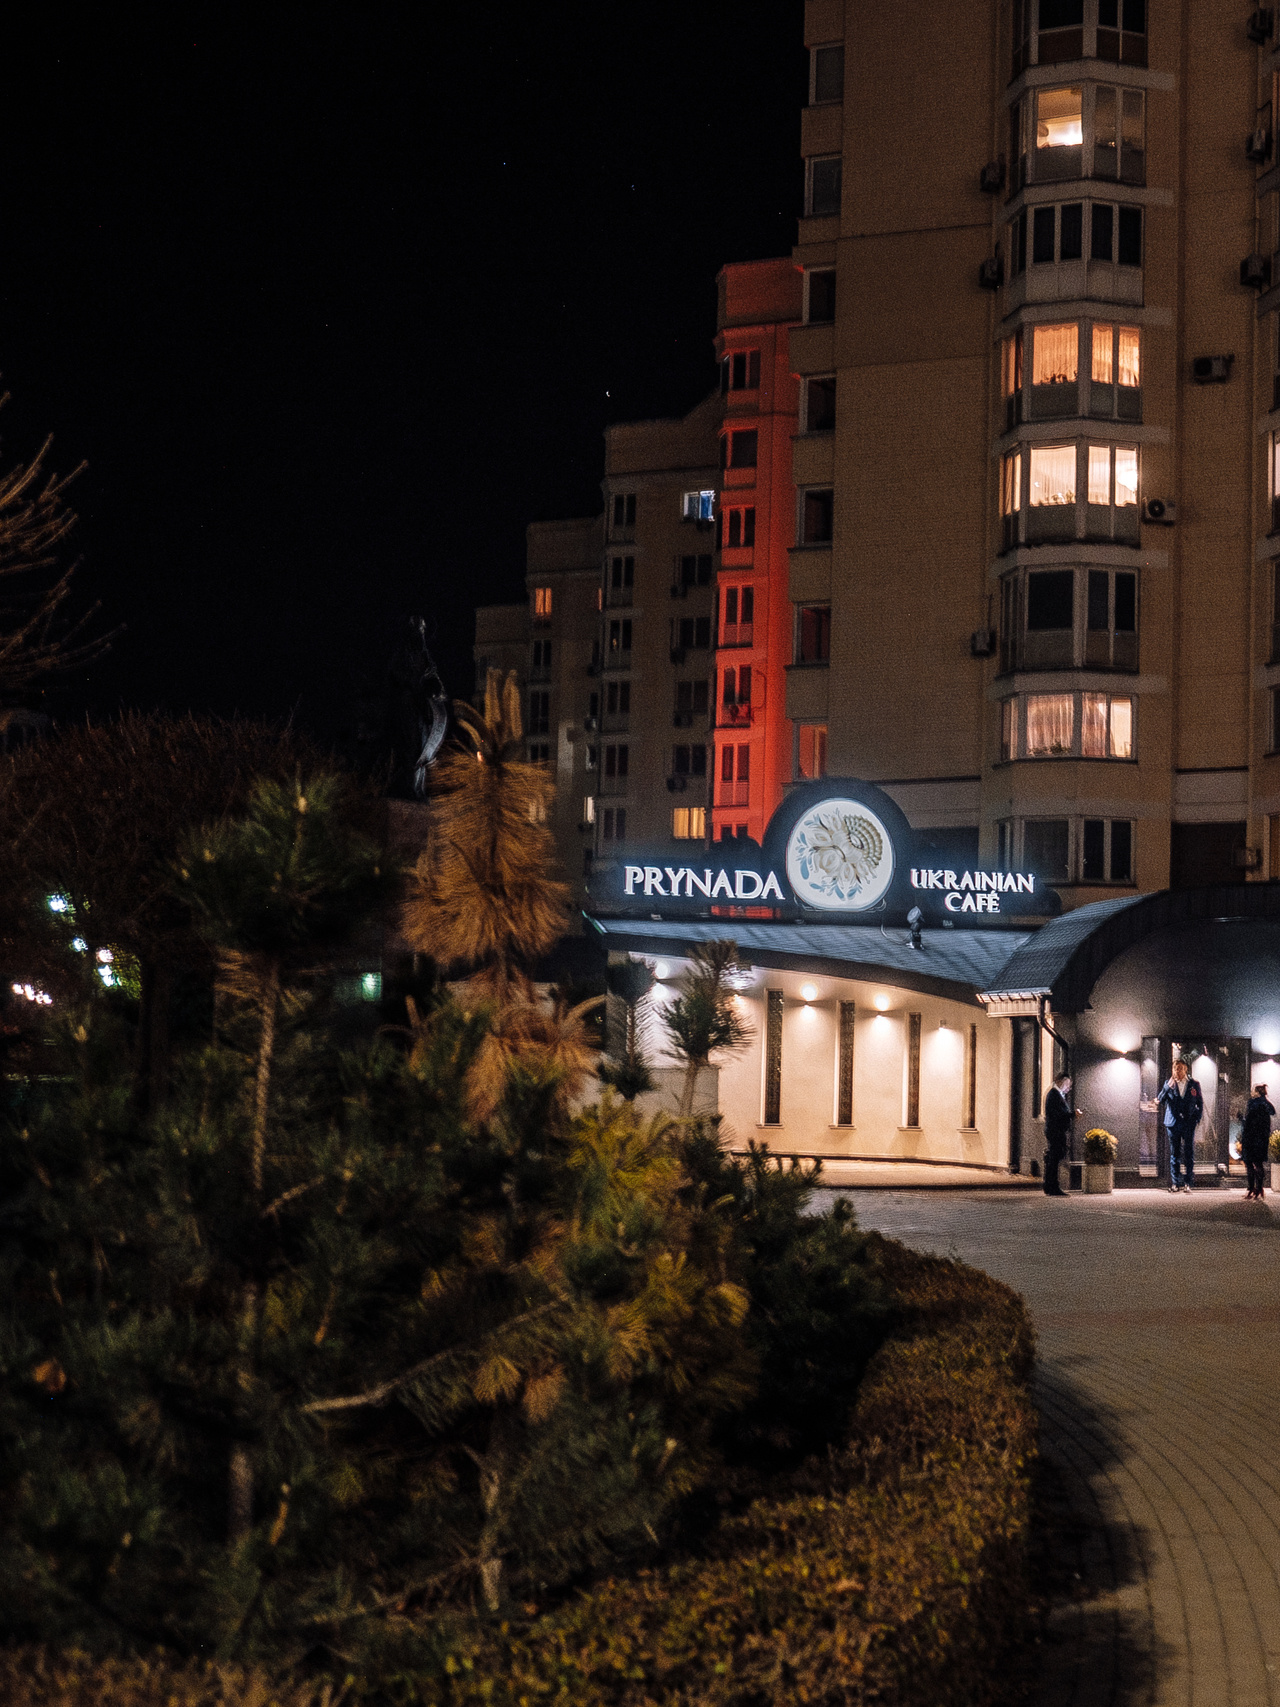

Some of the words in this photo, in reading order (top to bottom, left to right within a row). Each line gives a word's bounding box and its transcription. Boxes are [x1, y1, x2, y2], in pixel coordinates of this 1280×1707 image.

[624, 866, 786, 900] PRYNADA
[910, 868, 1035, 893] UKRAINIAN
[944, 890, 1001, 913] CAFÉ
